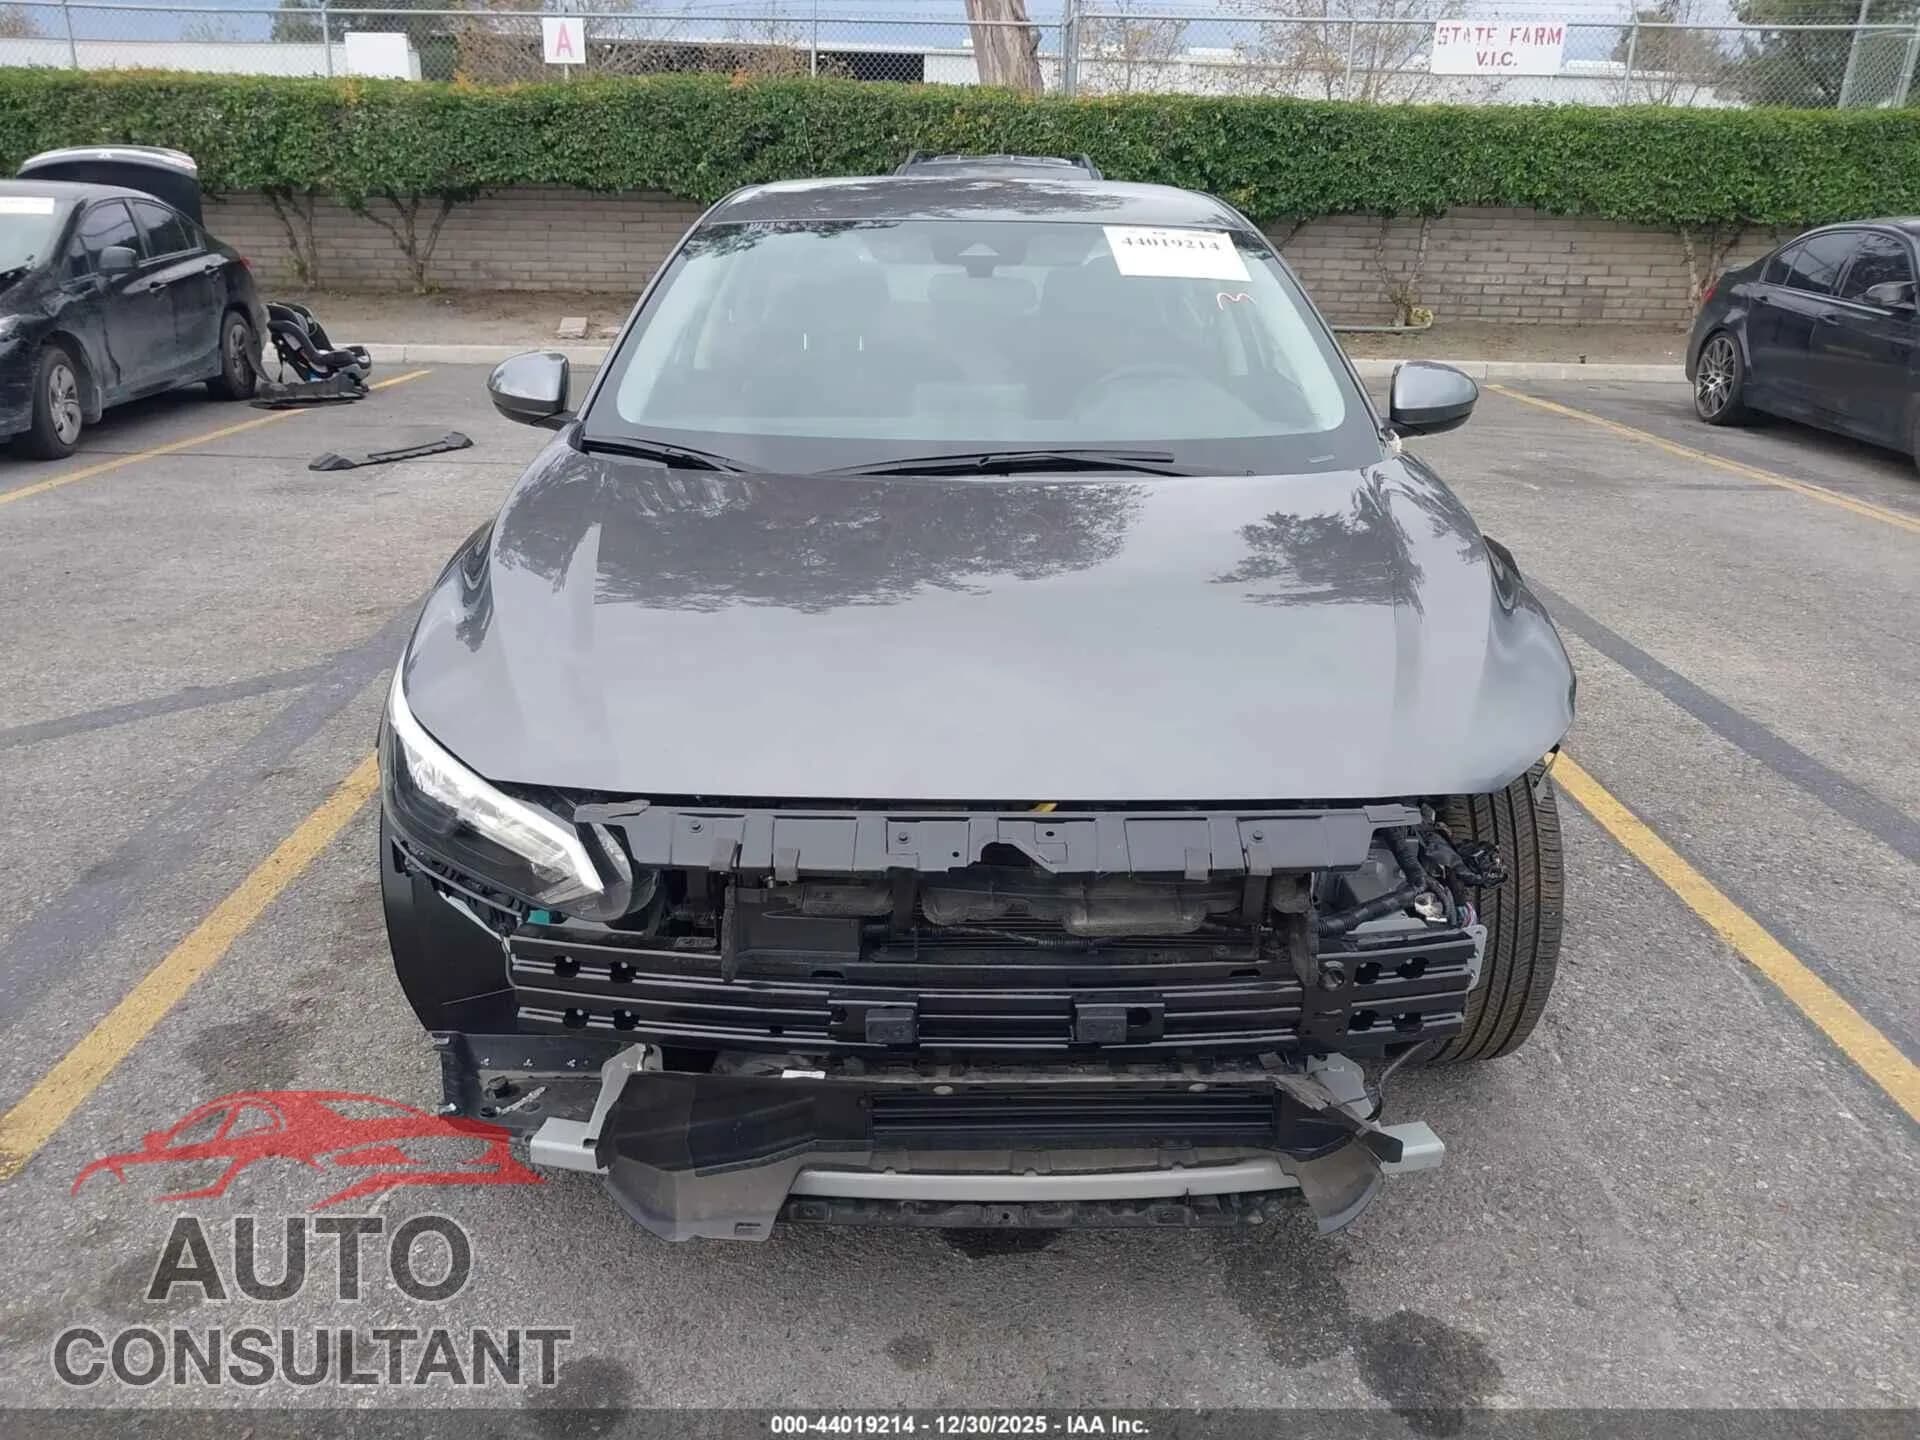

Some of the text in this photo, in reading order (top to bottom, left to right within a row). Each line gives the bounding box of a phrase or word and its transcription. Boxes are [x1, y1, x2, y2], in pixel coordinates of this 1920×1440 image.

[556, 22, 574, 58] A
[1437, 26, 1563, 46] STATE FARM
[1475, 51, 1519, 67] V.I.C.
[1121, 236, 1221, 251] 44019214
